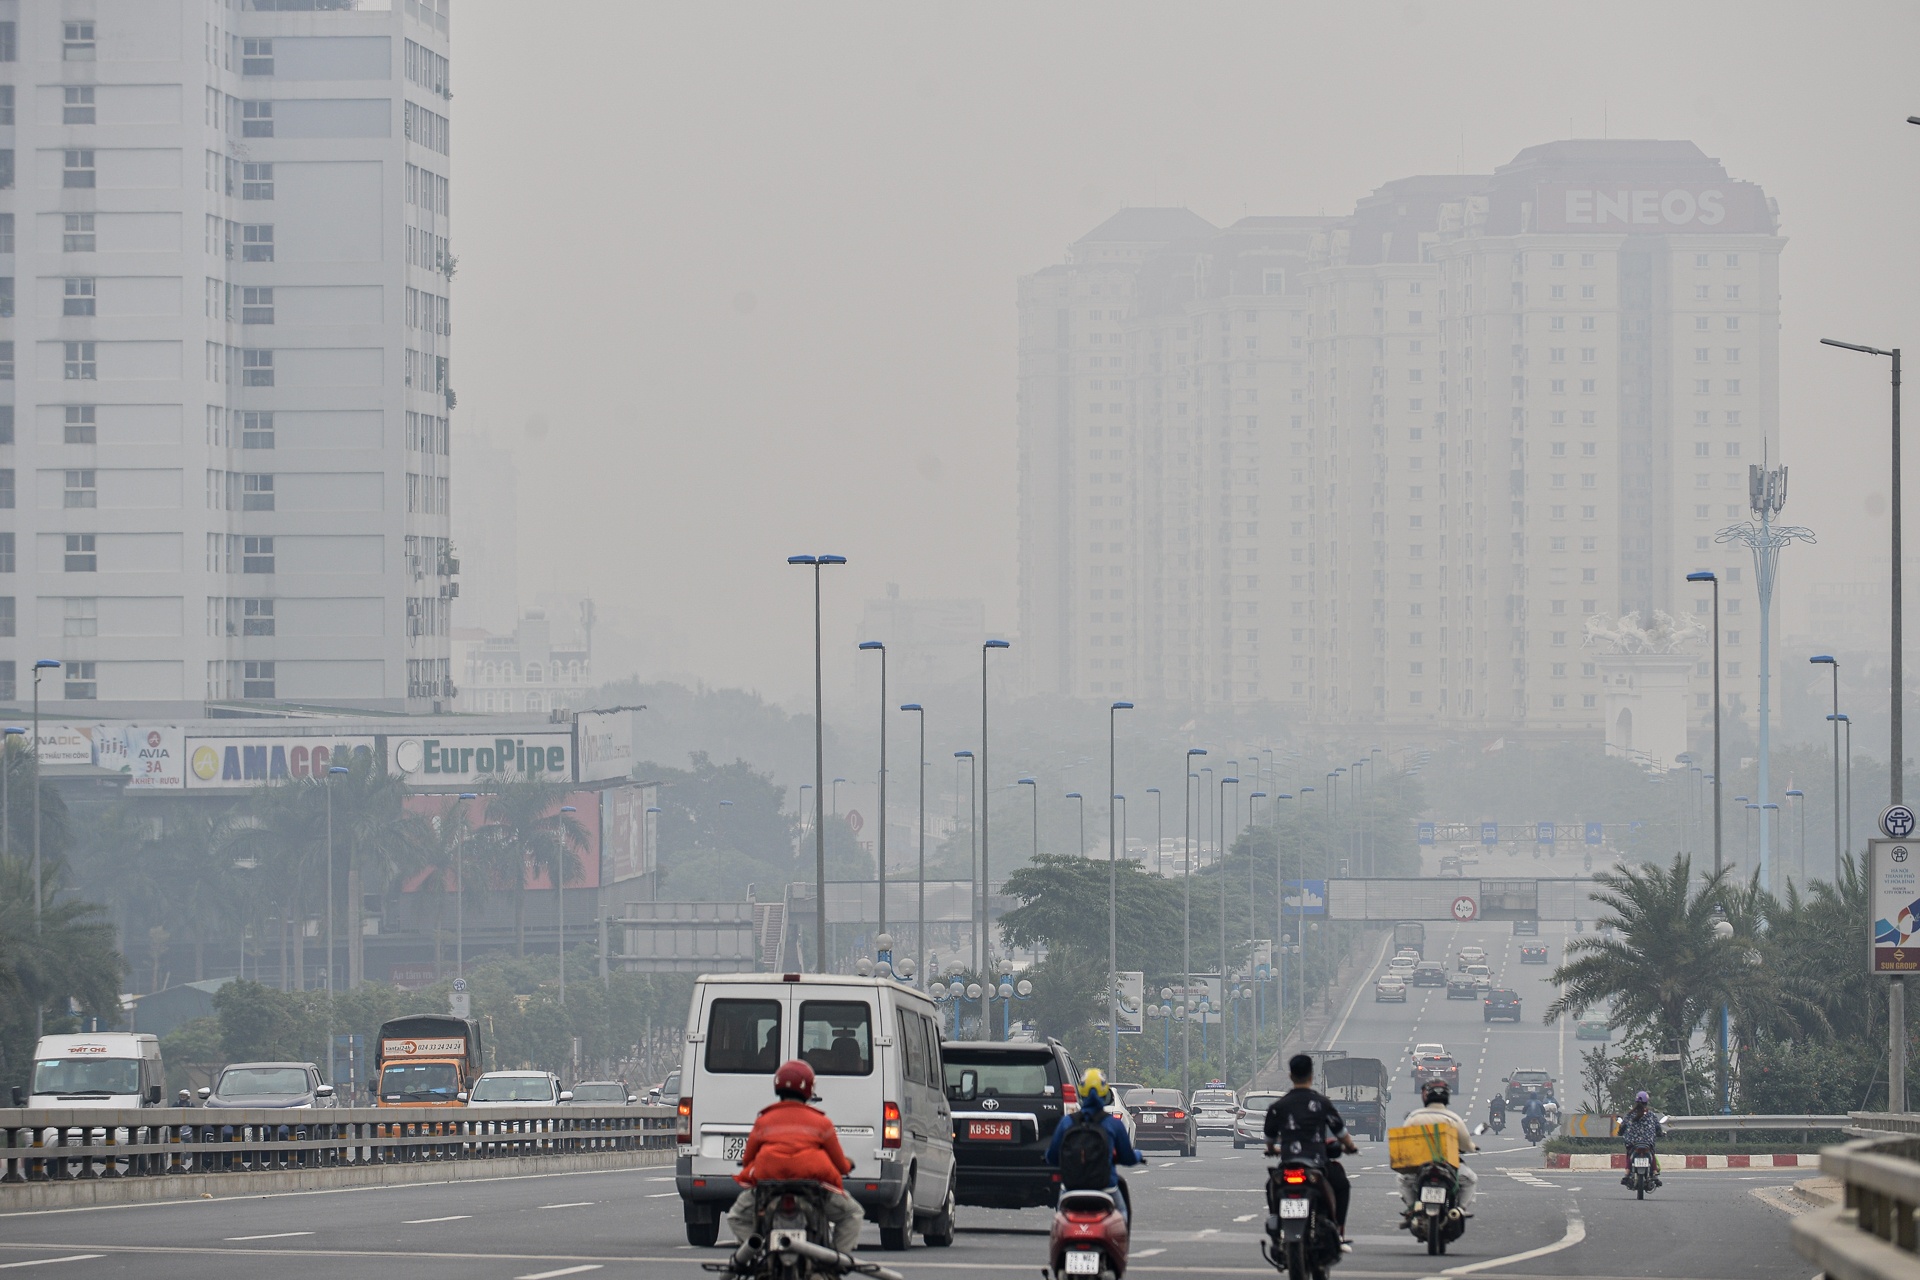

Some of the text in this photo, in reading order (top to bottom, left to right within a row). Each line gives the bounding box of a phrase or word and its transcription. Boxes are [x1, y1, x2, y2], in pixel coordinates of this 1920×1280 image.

[1565, 188, 1726, 226] ENEOS
[24, 736, 81, 745] VNADIC
[138, 748, 170, 758] AVIA
[423, 738, 565, 780] EuroPipe
[146, 760, 163, 773] 3A
[1880, 962, 1918, 970] SUN GROUP
[970, 1124, 1011, 1136] KB-55-68
